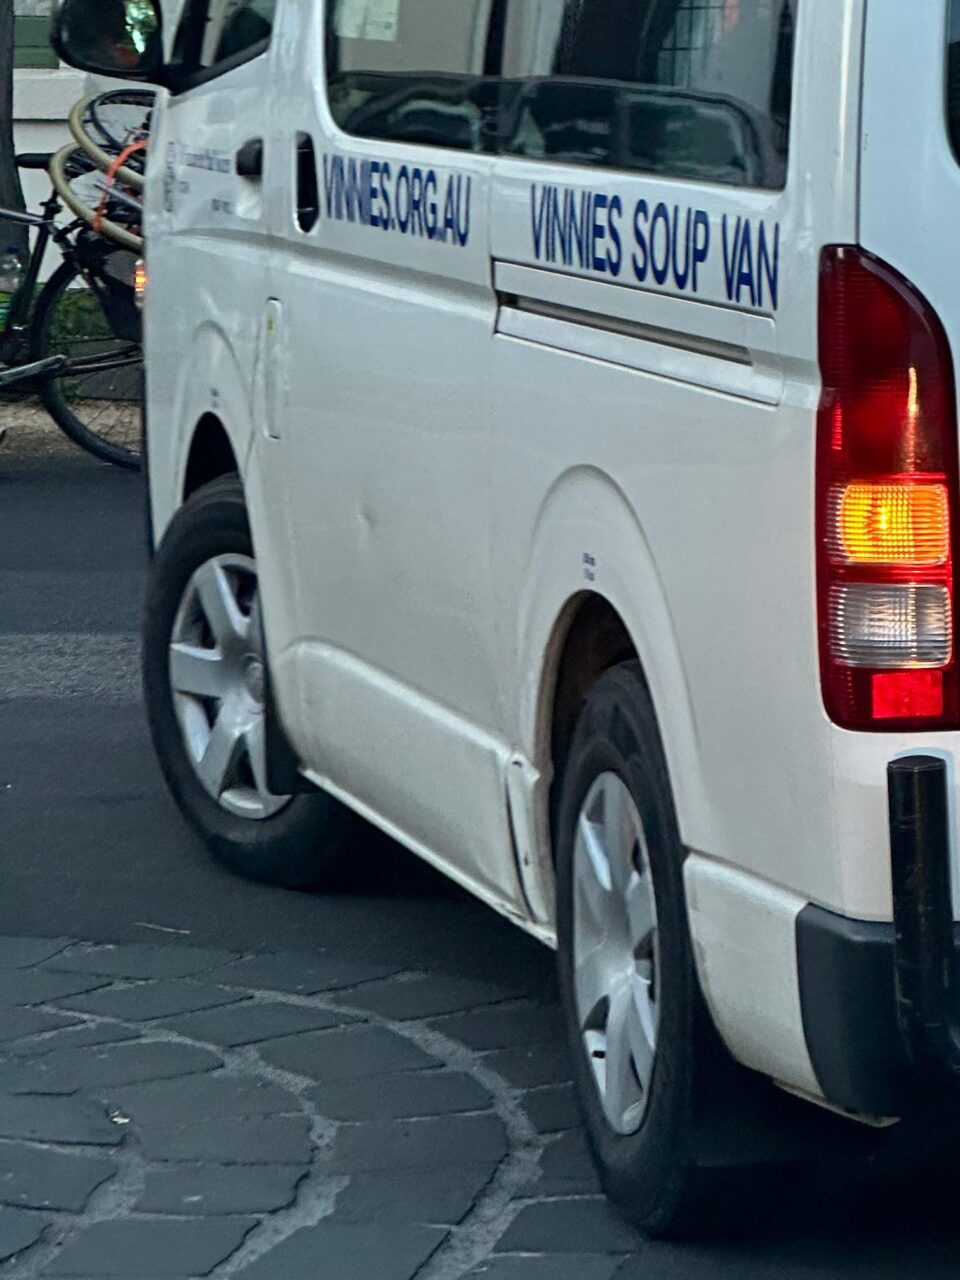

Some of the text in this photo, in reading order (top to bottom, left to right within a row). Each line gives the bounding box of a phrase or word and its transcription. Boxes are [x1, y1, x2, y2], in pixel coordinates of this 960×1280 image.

[323, 154, 472, 246] VINNIES.ORG.AU
[531, 183, 780, 310] VINNIES SOUP VAN
